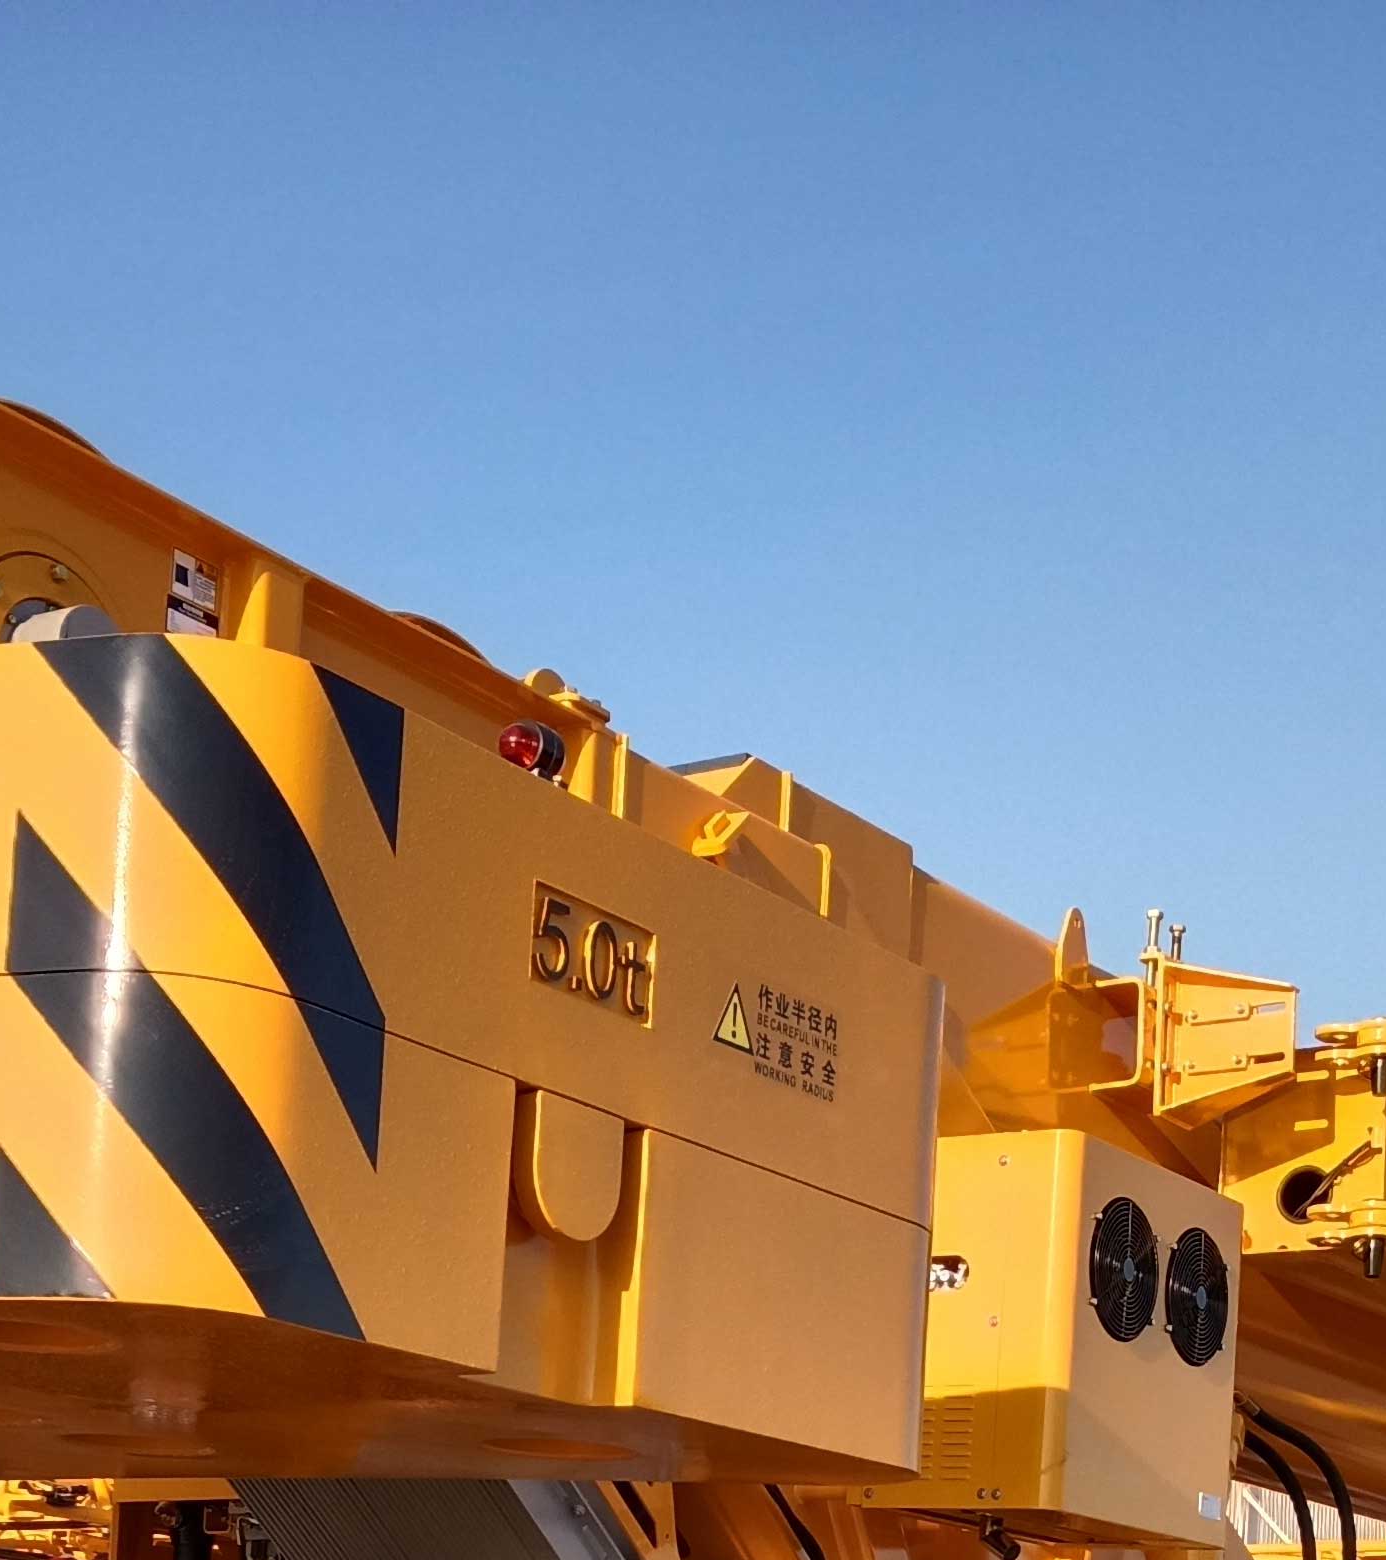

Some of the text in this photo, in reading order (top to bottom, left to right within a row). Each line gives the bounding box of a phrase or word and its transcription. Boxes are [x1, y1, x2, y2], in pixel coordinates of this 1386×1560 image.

[533, 896, 646, 1016] 5.0t
[757, 1012, 837, 1057] BE CAREFUL IN THE
[758, 983, 837, 1041] 作业半径内
[754, 1061, 834, 1102] WORKING RADIUS
[755, 1032, 836, 1087] 注意安全
